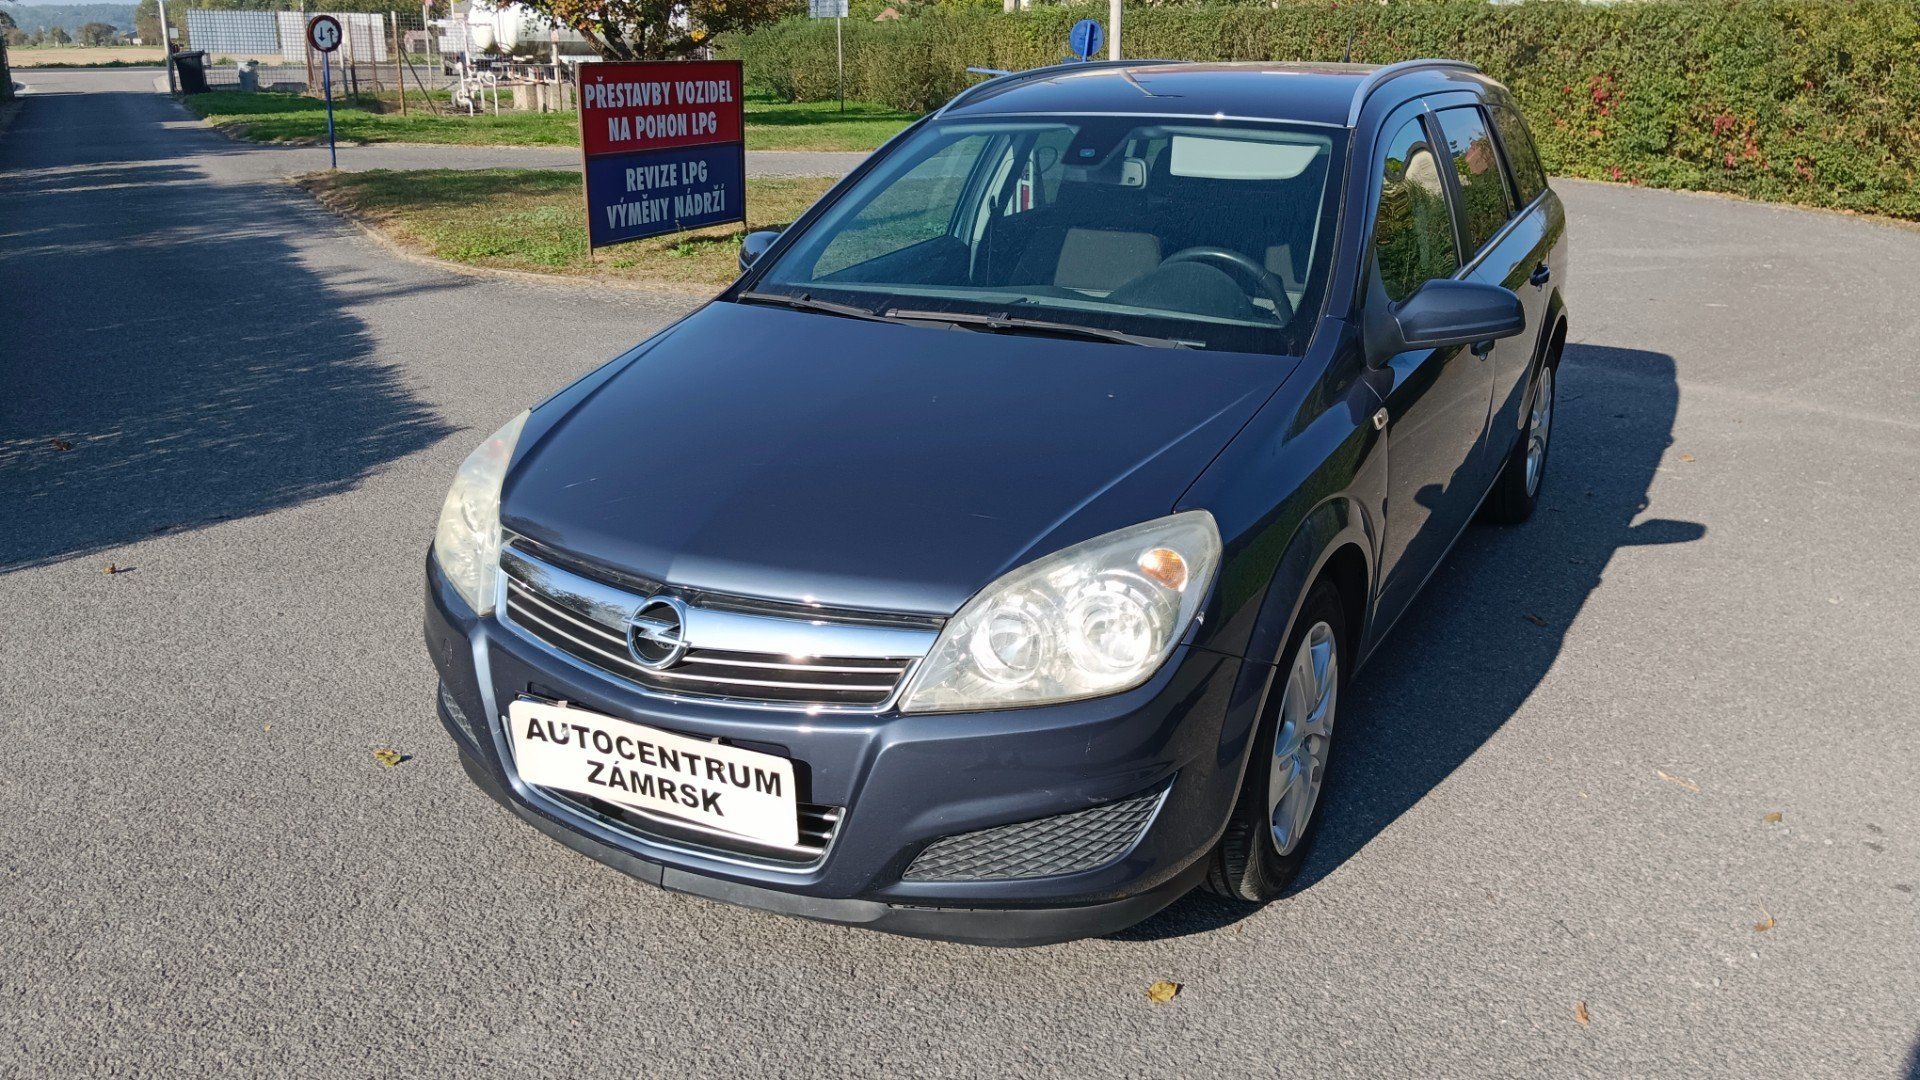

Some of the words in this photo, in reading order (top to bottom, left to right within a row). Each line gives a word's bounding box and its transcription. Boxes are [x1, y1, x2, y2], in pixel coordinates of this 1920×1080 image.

[584, 76, 671, 109] PŘESTAVBY
[675, 80, 733, 105] VOZIDEL
[608, 116, 631, 142] NA
[635, 113, 687, 140] POHON
[692, 111, 717, 135] LPG
[626, 163, 677, 192] REVIZE
[682, 160, 708, 184] LPG
[606, 193, 670, 229] VÝMĚNY
[674, 183, 725, 218] NÁDRŽÍ
[526, 718, 782, 797] AUTOCENTRUM
[586, 760, 725, 817] ZÁMRSK
